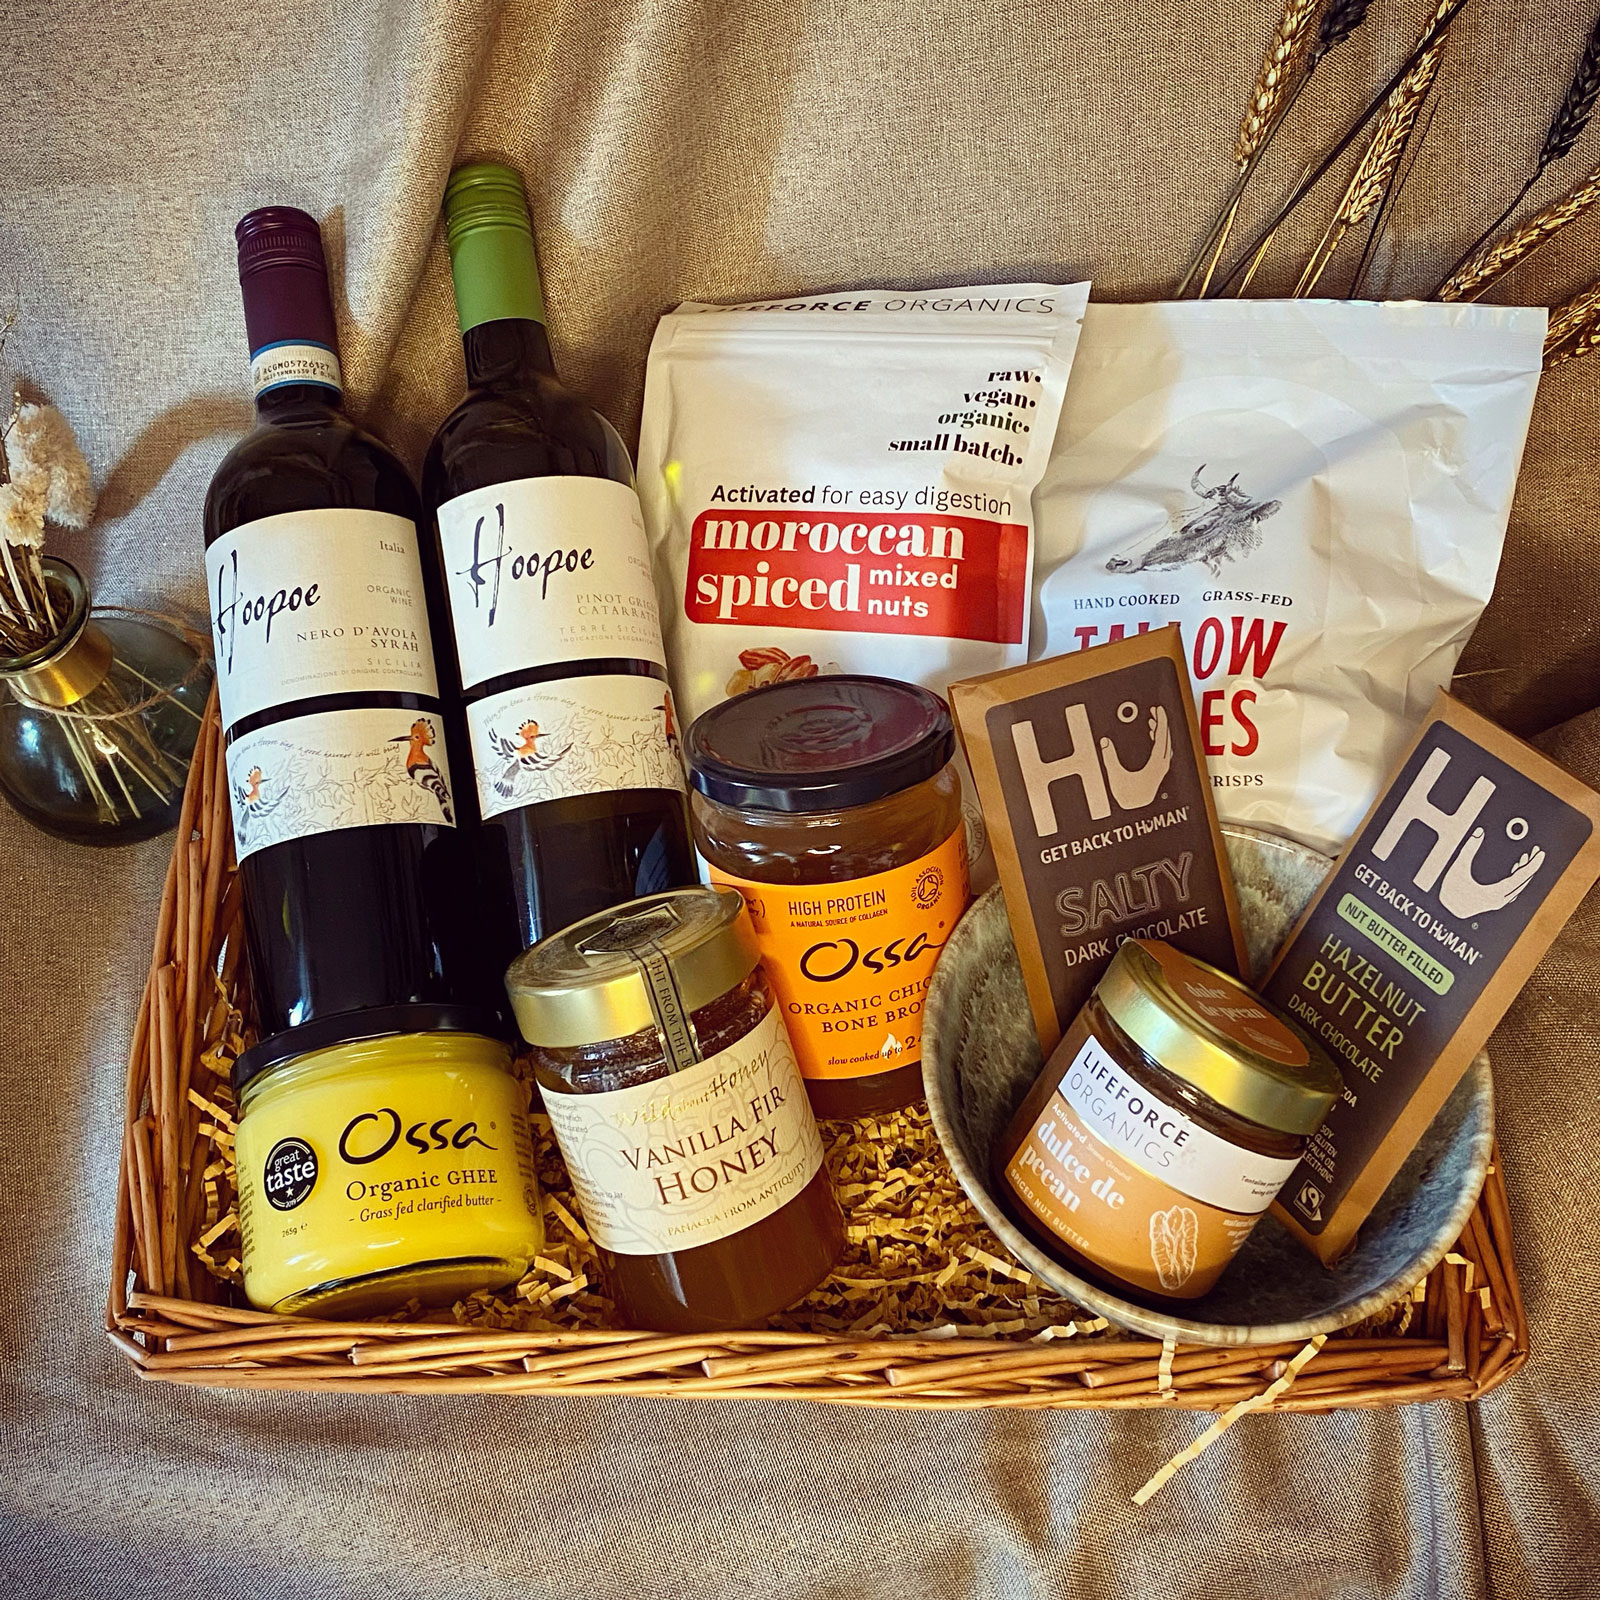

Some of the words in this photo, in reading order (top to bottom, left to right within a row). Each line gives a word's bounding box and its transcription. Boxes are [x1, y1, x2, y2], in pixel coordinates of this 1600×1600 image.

[884, 298, 1055, 314] ORGANICS
[887, 433, 949, 453] small
[710, 484, 816, 504] Activated
[821, 485, 852, 504] for
[858, 489, 907, 511] easy
[914, 486, 1012, 517] digestion
[379, 540, 405, 554] Italia
[700, 518, 966, 561] moroccan
[455, 503, 595, 628] Hoopoe
[869, 564, 958, 590] mixed
[366, 584, 411, 598] ORGANIC
[389, 596, 414, 608] WINE
[576, 593, 623, 604] PINOT
[695, 561, 861, 620] spiced
[867, 595, 930, 618] nuts
[1073, 596, 1115, 610] HAND
[1118, 594, 1180, 607] COOKED
[1202, 590, 1293, 607] GRASS-FED
[213, 549, 321, 677] Hoopoe
[559, 624, 607, 634] TERRE
[297, 627, 345, 643] NERO
[370, 638, 419, 652] SYRAH
[367, 657, 422, 668] SICILIA
[1210, 774, 1264, 788] RISPS
[1040, 843, 1069, 864] GET
[1071, 831, 1113, 856] BACK
[1113, 825, 1134, 843] TO
[788, 900, 822, 916] HIGH
[827, 888, 886, 914] PROTEIN
[1056, 852, 1193, 936] SALTY
[1353, 863, 1381, 889] GET
[1376, 881, 1416, 915] BACK
[1412, 905, 1432, 929] TO
[790, 920, 795, 928] A
[796, 920, 823, 928] NATURAL
[825, 917, 848, 927] SOURCE
[849, 915, 857, 923] OF
[858, 908, 888, 922] COLLAGEN
[799, 931, 947, 983] Ossa
[1064, 938, 1113, 967] DARK
[1345, 902, 1370, 925] NUT
[1367, 919, 1407, 956] BUTTER
[1406, 950, 1444, 985] FILLED
[1320, 933, 1426, 1027] HAZELNUT
[659, 987, 678, 1027] FROM
[672, 1027, 688, 1055] THE
[788, 995, 882, 1015] ORGANIC
[1302, 960, 1404, 1060] BUTTER
[822, 1015, 879, 1034] BONE
[1288, 994, 1322, 1029] DARK
[1320, 1021, 1383, 1084] CHOCOLATE
[828, 1056, 848, 1065] slow
[849, 1050, 880, 1063] cooked
[881, 1049, 892, 1059] up
[894, 1046, 903, 1054] to
[611, 1094, 676, 1128] Wild
[709, 1050, 770, 1099] Honey
[1083, 1051, 1191, 1148] LIFEFORCE
[338, 1107, 499, 1165] Ossa
[619, 1115, 747, 1171] VANILLA
[749, 1085, 786, 1124] FIR
[1052, 1102, 1087, 1144] Activated
[1070, 1073, 1175, 1167] ORGANICS
[1320, 1124, 1335, 1140] SOY
[274, 1149, 301, 1172] great
[1308, 1142, 1326, 1162] PALM
[1325, 1157, 1336, 1172] OIL
[1314, 1133, 1338, 1158] GLUTEN
[266, 1161, 316, 1193] taste
[653, 1126, 779, 1206] HONEY
[1018, 1144, 1082, 1213] pecan
[1037, 1119, 1091, 1184] dulce
[1091, 1176, 1126, 1210] de
[346, 1171, 441, 1202] Organic
[447, 1169, 498, 1185] GHEE
[667, 1214, 721, 1236] PANACEA
[723, 1197, 757, 1219] FROM
[759, 1158, 805, 1202] ANTIQUITY
[359, 1207, 393, 1222] Grass
[394, 1200, 414, 1221] fed
[416, 1194, 463, 1214] clarified
[465, 1193, 494, 1207] butter
[1010, 1168, 1033, 1200] SPICED
[1034, 1197, 1053, 1219] NUT
[1052, 1216, 1090, 1250] BUTTER
